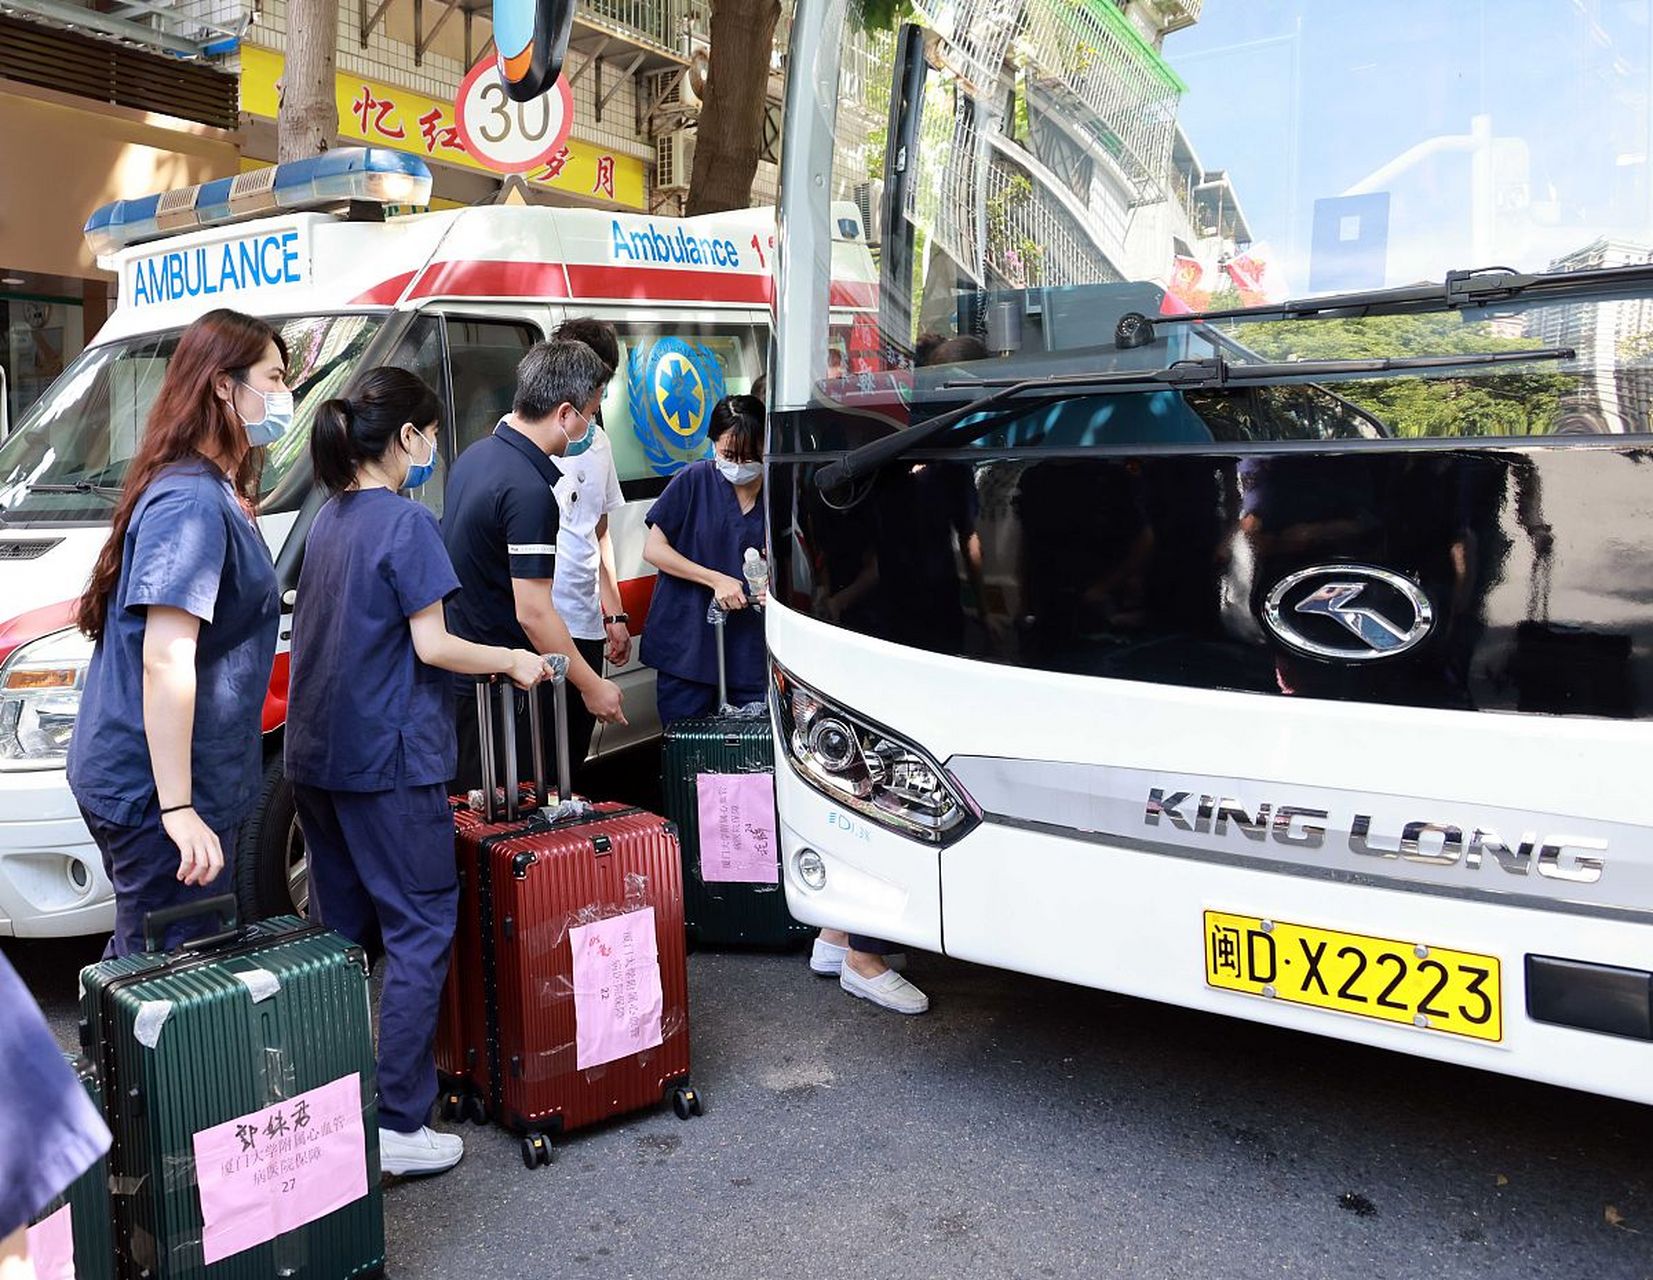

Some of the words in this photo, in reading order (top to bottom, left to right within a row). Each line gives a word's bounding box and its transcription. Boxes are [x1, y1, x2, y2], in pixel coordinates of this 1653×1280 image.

[478, 83, 550, 143] 30
[134, 232, 301, 307] AMBULANCE
[612, 220, 739, 268] Ambulance
[1144, 787, 1329, 851] KING
[1348, 813, 1609, 884] LONG
[600, 986, 610, 1000] 22
[281, 1178, 297, 1193] 27
